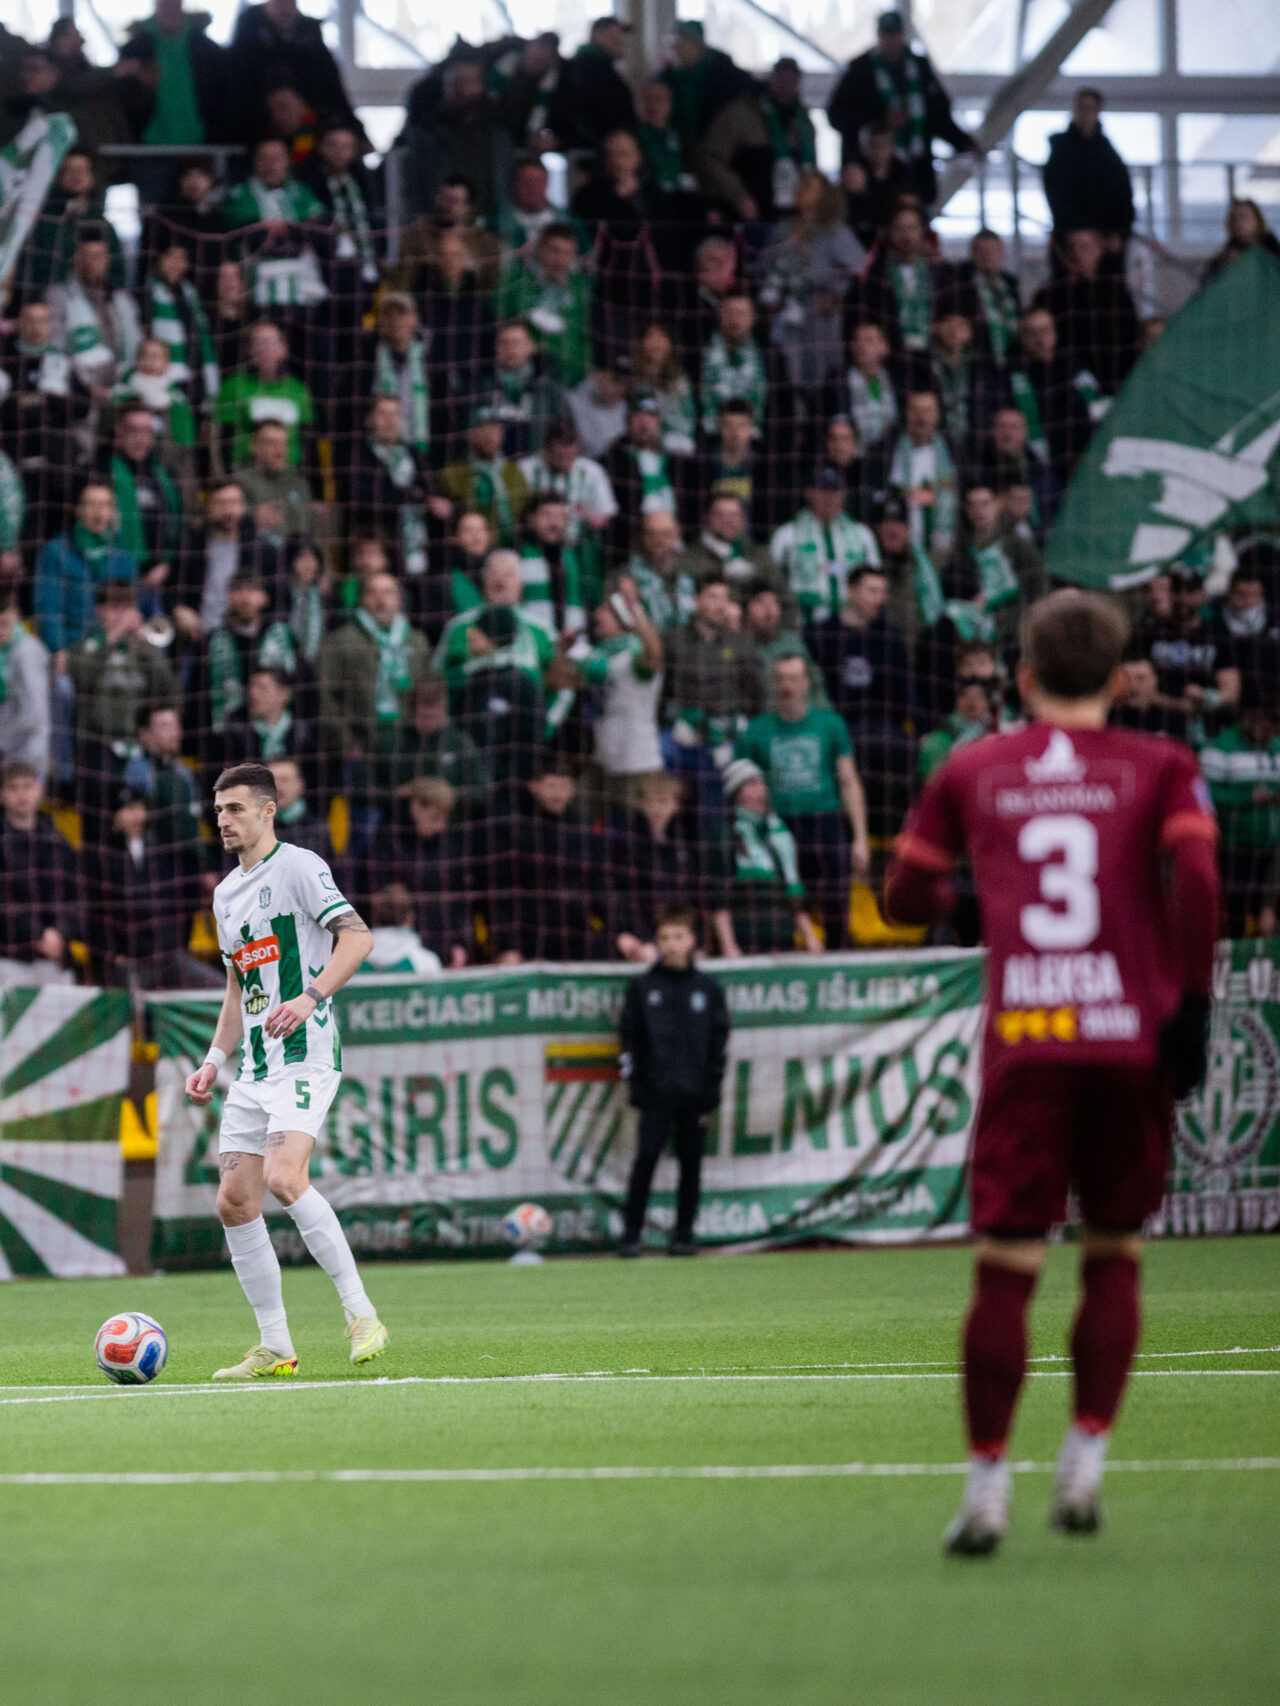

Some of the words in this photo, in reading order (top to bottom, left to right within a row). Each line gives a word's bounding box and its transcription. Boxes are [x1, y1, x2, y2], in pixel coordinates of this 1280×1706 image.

[1019, 812, 1102, 952] 3
[234, 943, 279, 972] bsson
[247, 996, 269, 1013] 1410
[725, 979, 809, 1012] IMAS
[294, 1079, 311, 1110] 5
[184, 1067, 518, 1185] GIRIS
[702, 1038, 971, 1156] LNIUS
